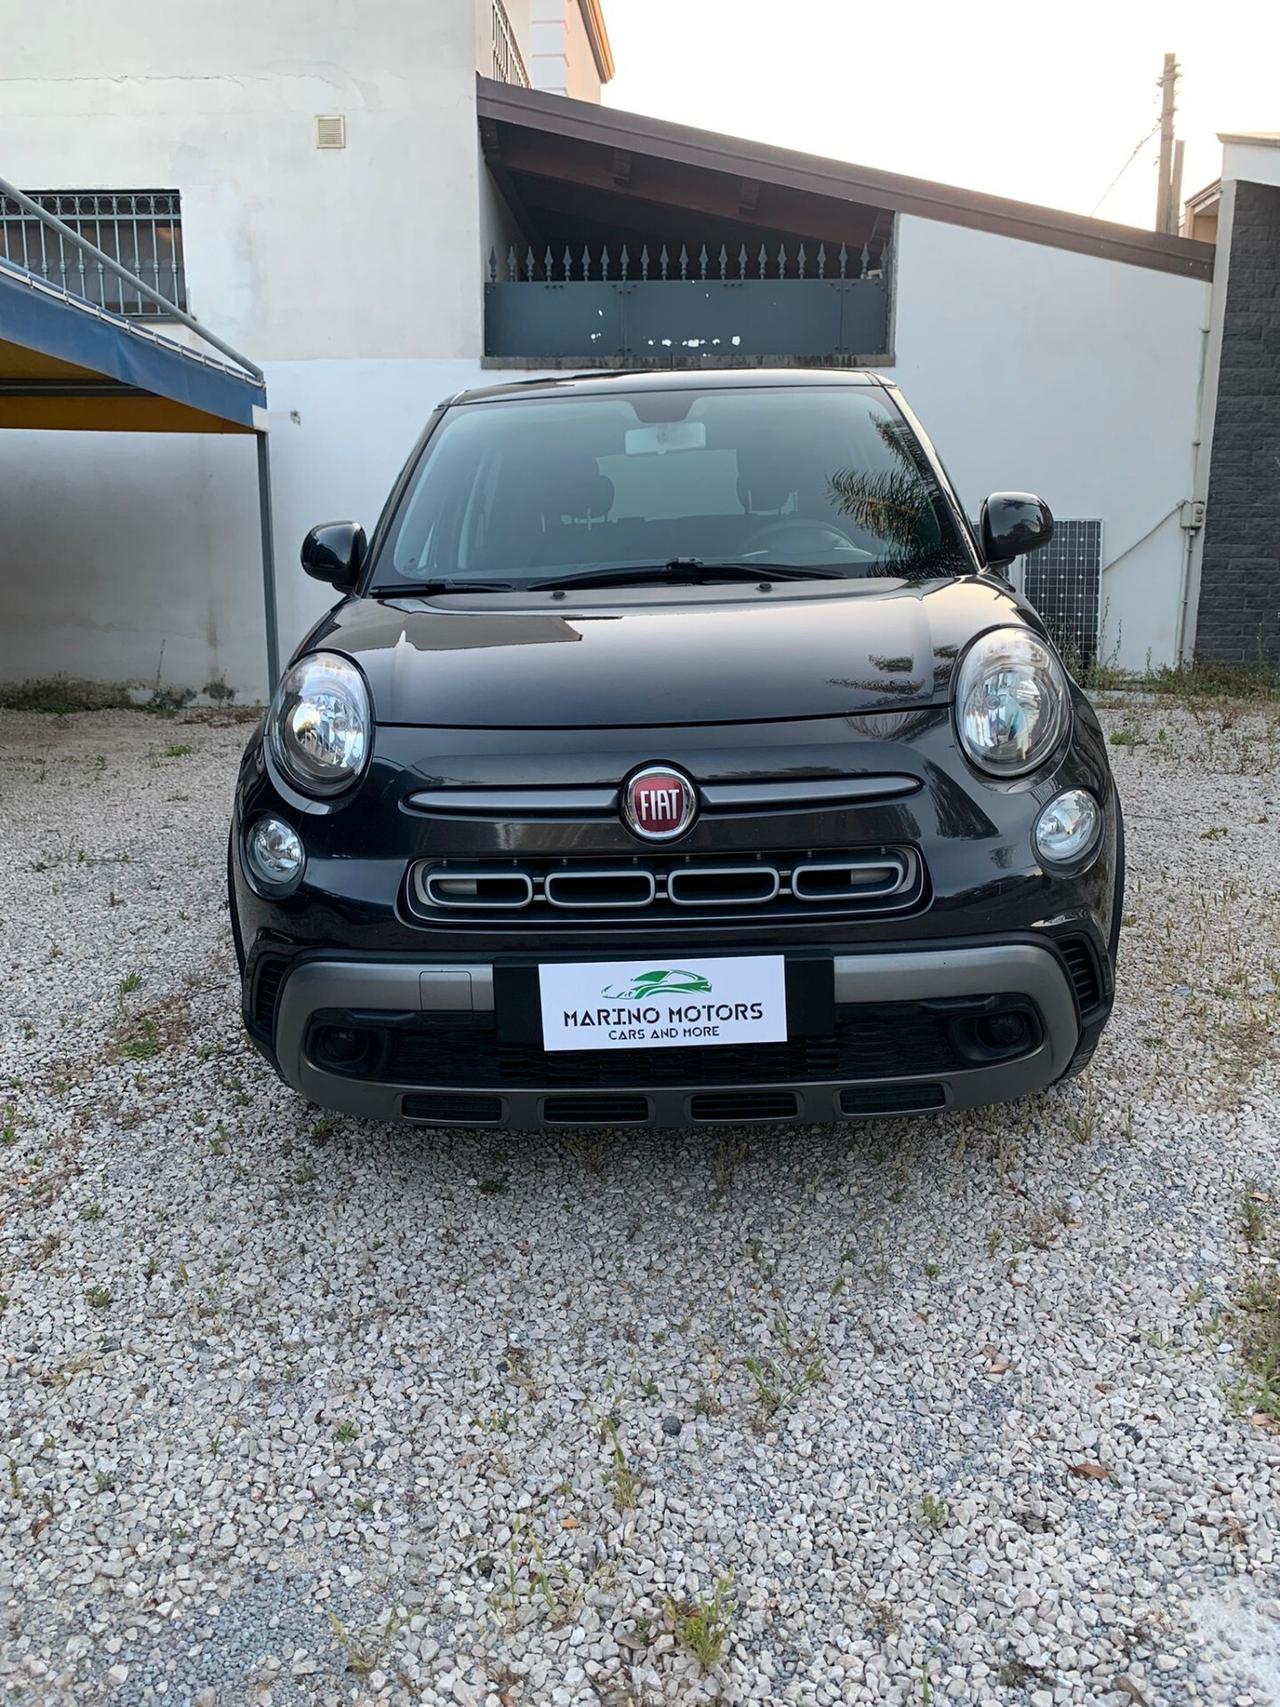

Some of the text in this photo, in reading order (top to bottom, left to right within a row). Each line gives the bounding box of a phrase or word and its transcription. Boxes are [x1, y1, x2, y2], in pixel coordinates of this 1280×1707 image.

[640, 789, 680, 820] FIAT
[563, 1003, 763, 1027] MARINO MOTORS
[608, 1026, 720, 1041] CARS AND MORE
